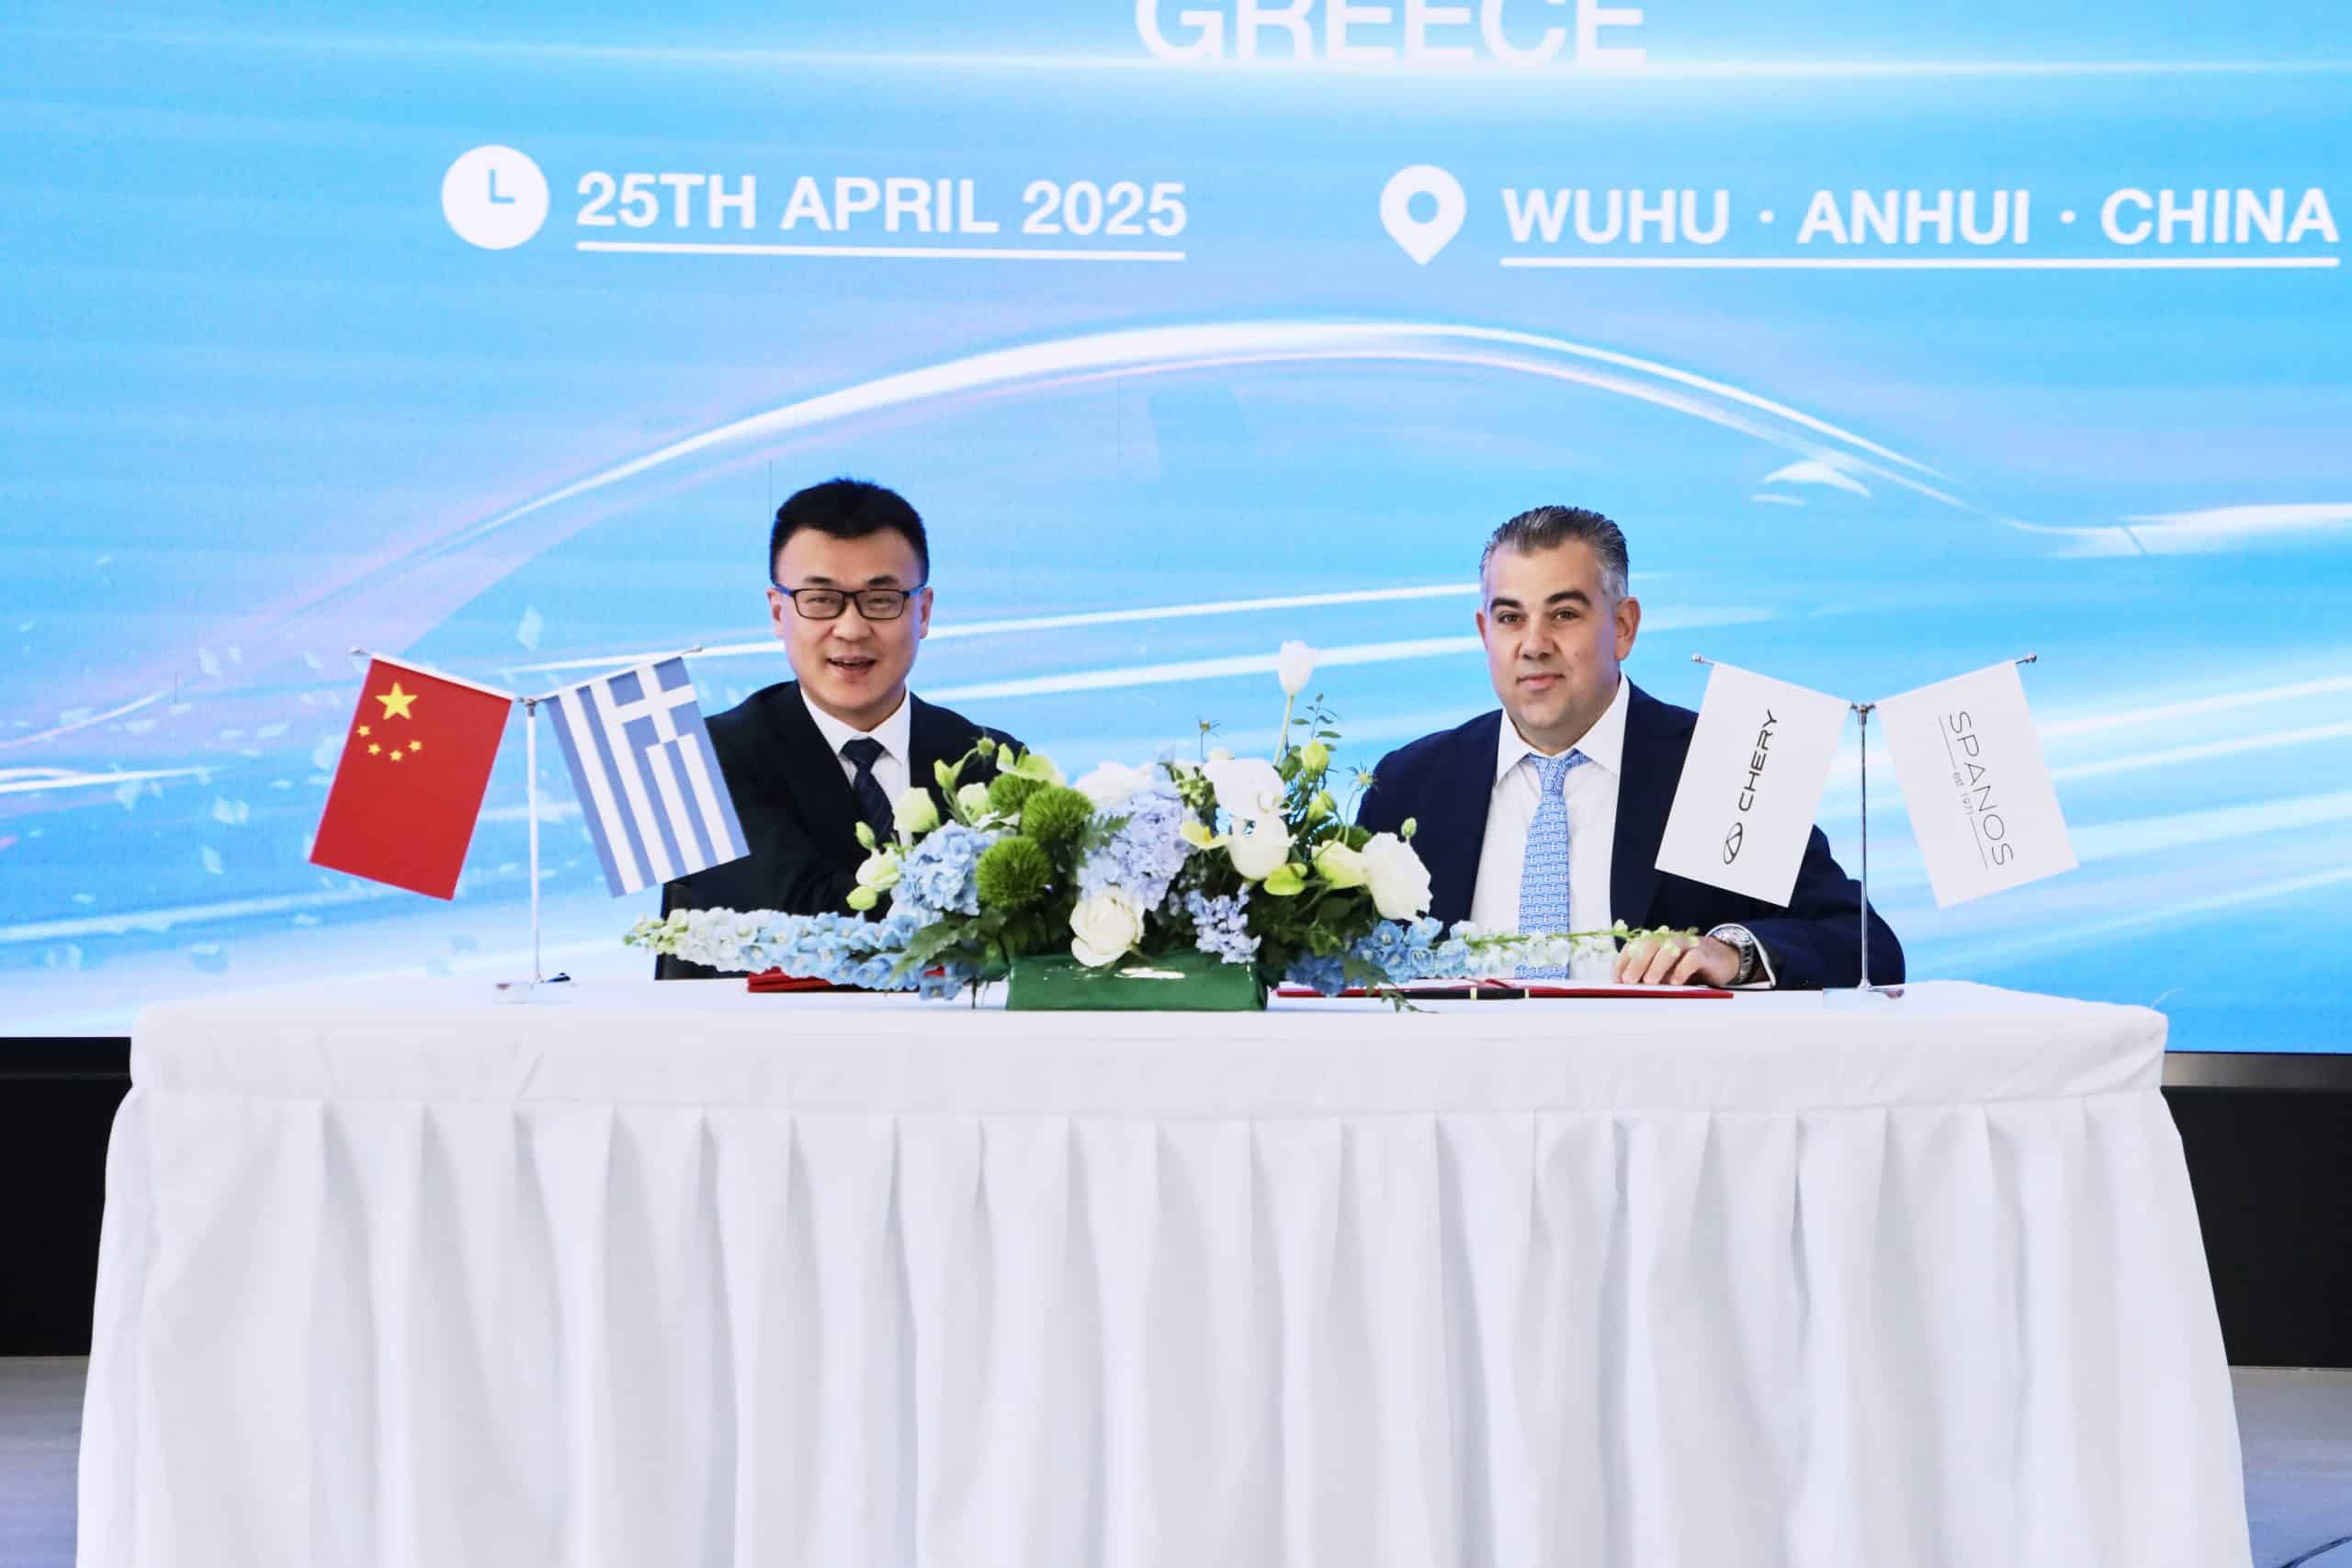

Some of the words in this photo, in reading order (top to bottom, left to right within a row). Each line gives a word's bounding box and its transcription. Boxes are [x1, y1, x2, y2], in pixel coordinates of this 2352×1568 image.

[1135, 0, 1647, 66] GREECE
[576, 171, 756, 230] 25TH
[780, 176, 999, 233] APRIL
[1022, 181, 1187, 237] 2025
[1502, 188, 1729, 244] WUHU
[1797, 189, 2029, 244] ANHUI
[2100, 187, 2340, 244] CHINA
[1738, 708, 1778, 812] CHERY
[1949, 710, 2014, 866] SPANOS
